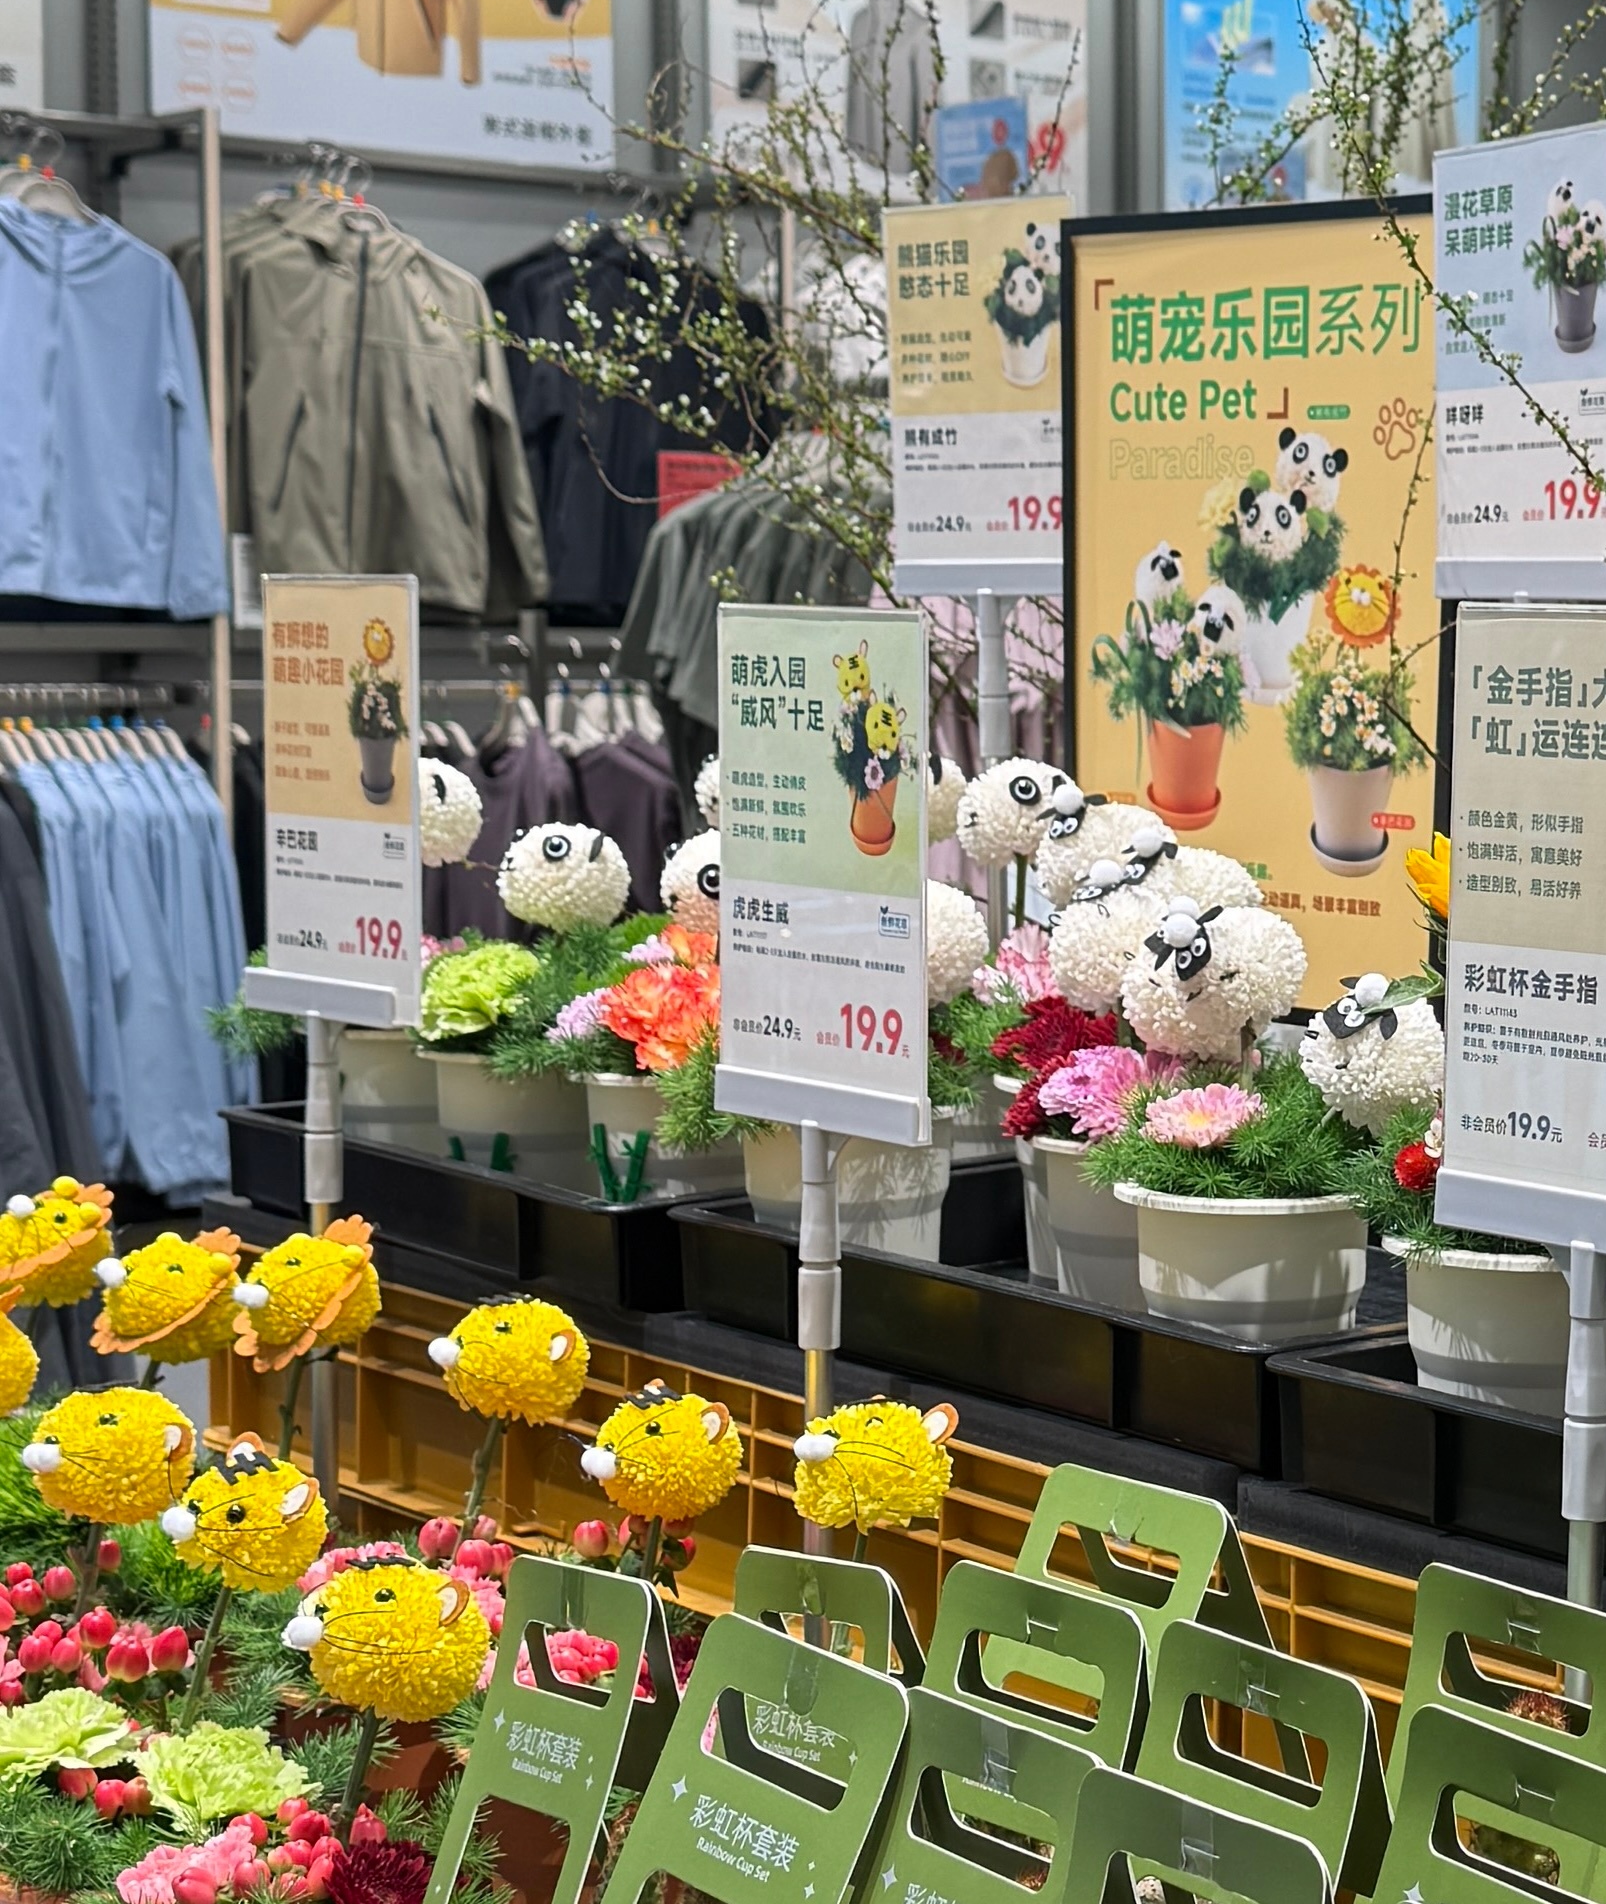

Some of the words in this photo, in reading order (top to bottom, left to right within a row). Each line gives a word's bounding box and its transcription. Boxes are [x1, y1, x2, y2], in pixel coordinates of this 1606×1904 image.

[1444, 184, 1513, 221] 漫花草原
[898, 240, 969, 268] 熊猫乐园
[1445, 221, 1513, 257] 呆萌咩咩
[1110, 279, 1421, 364] 萌宠乐园系列
[1110, 382, 1187, 423] Cute
[1200, 379, 1257, 420] Pet
[1109, 434, 1255, 481] Paradise
[731, 654, 806, 689] 萌虎入园
[733, 896, 789, 925] 虎虎生威
[1464, 963, 1598, 1005] 彩虹杯金手指
[506, 1721, 583, 1770] 彩虹杯套装
[511, 1757, 537, 1779] Rainbow
[538, 1766, 553, 1784] Cup
[551, 1770, 564, 1785] Set
[689, 1794, 799, 1872] 彩虹杯套装
[696, 1836, 735, 1867] Rainbow
[735, 1855, 754, 1878] Cup
[753, 1863, 771, 1884] Set
